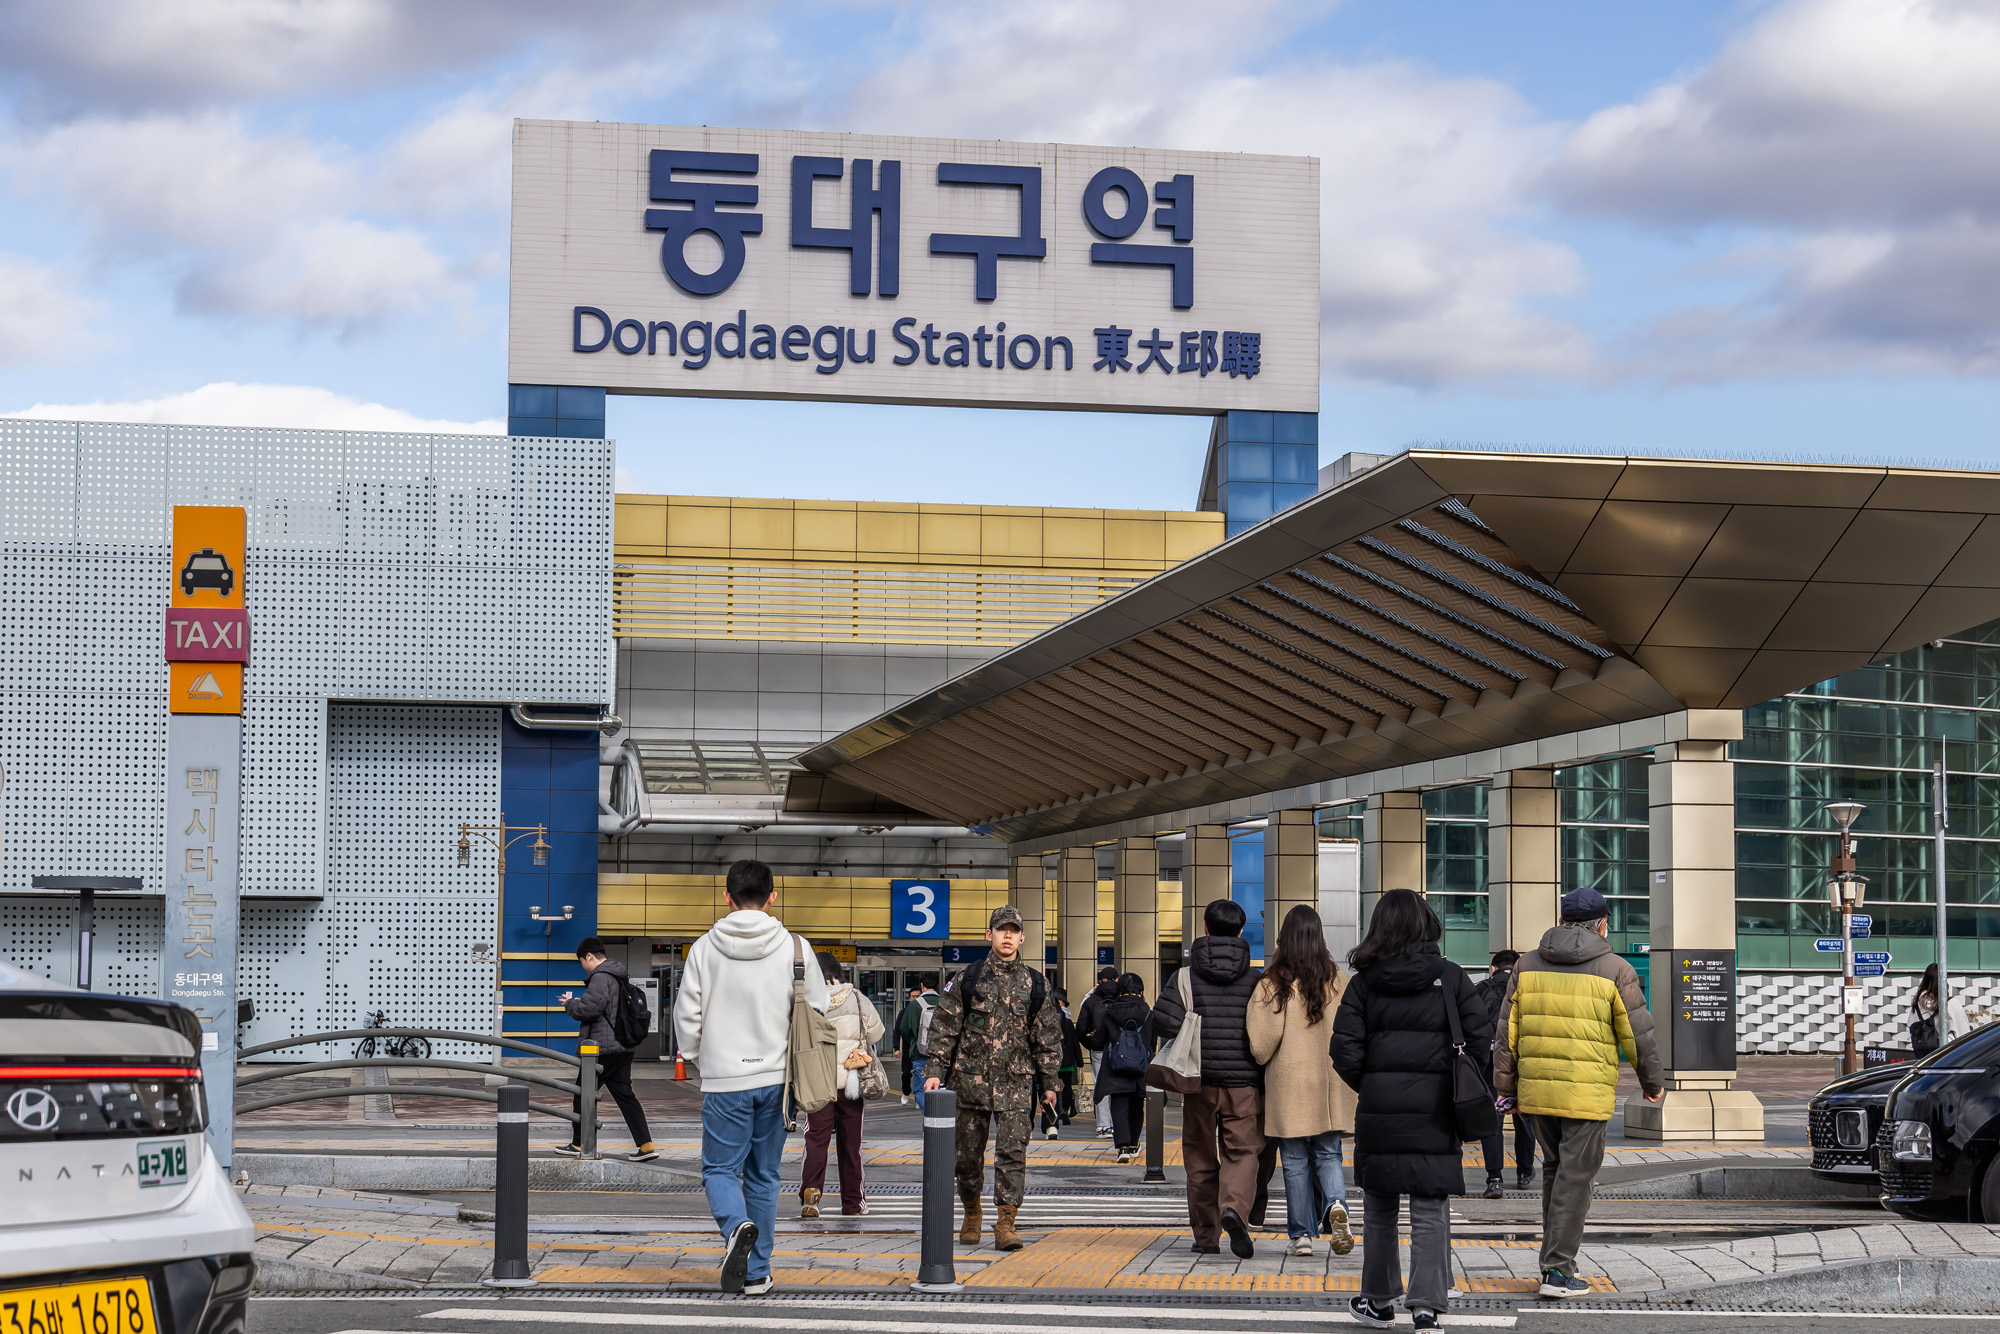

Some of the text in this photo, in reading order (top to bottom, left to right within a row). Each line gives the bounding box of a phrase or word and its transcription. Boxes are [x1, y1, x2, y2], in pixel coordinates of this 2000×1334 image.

[645, 149, 1195, 309] 동대구역
[573, 306, 1262, 379] Dongdaegu Station 東大邱驛
[170, 620, 242, 649] TAXI
[905, 885, 936, 934] 3
[952, 948, 960, 961] 3
[172, 988, 226, 998] Dongdaegu Stn.
[174, 972, 223, 986] 동대구역
[71, 1288, 144, 1334] 1678
